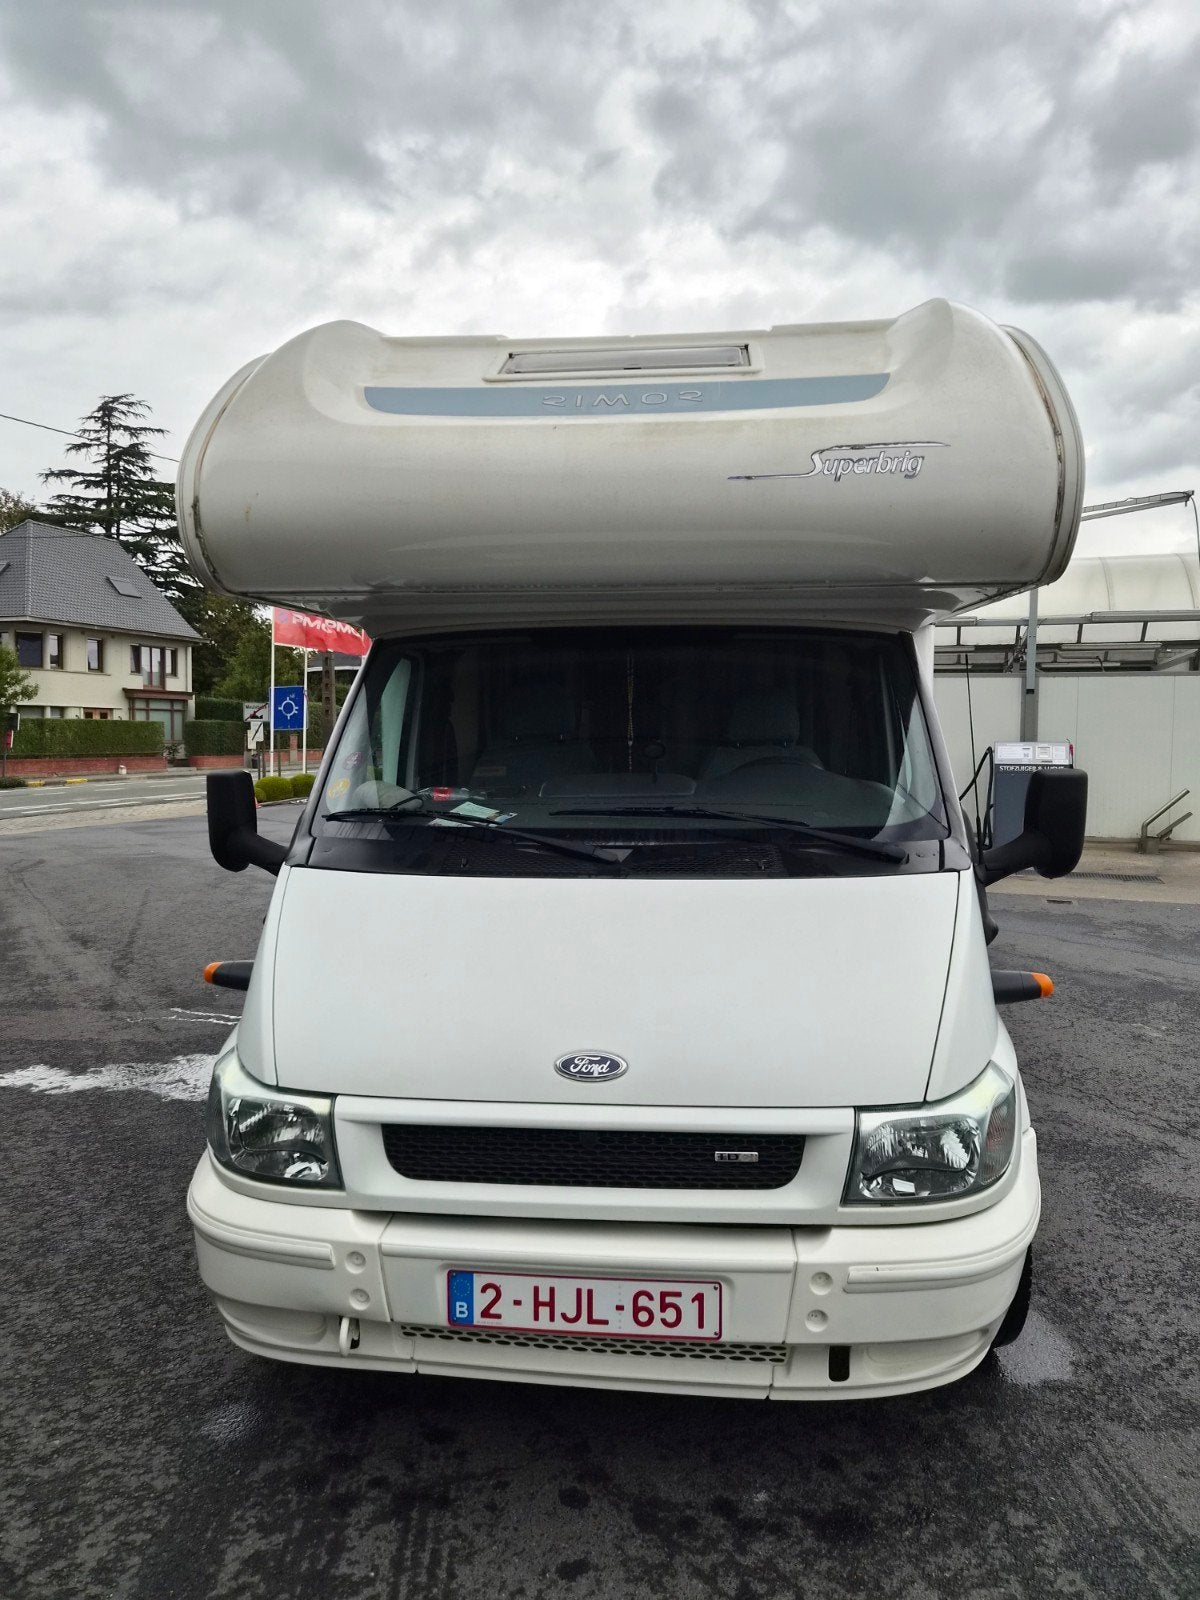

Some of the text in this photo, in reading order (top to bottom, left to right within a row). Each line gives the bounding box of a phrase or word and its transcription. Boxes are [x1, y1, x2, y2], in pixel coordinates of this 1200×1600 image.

[800, 443, 926, 482] Superbrig
[569, 1055, 611, 1076] Ford
[455, 1301, 469, 1318] B
[480, 1282, 705, 1330] 2-HJL-651
